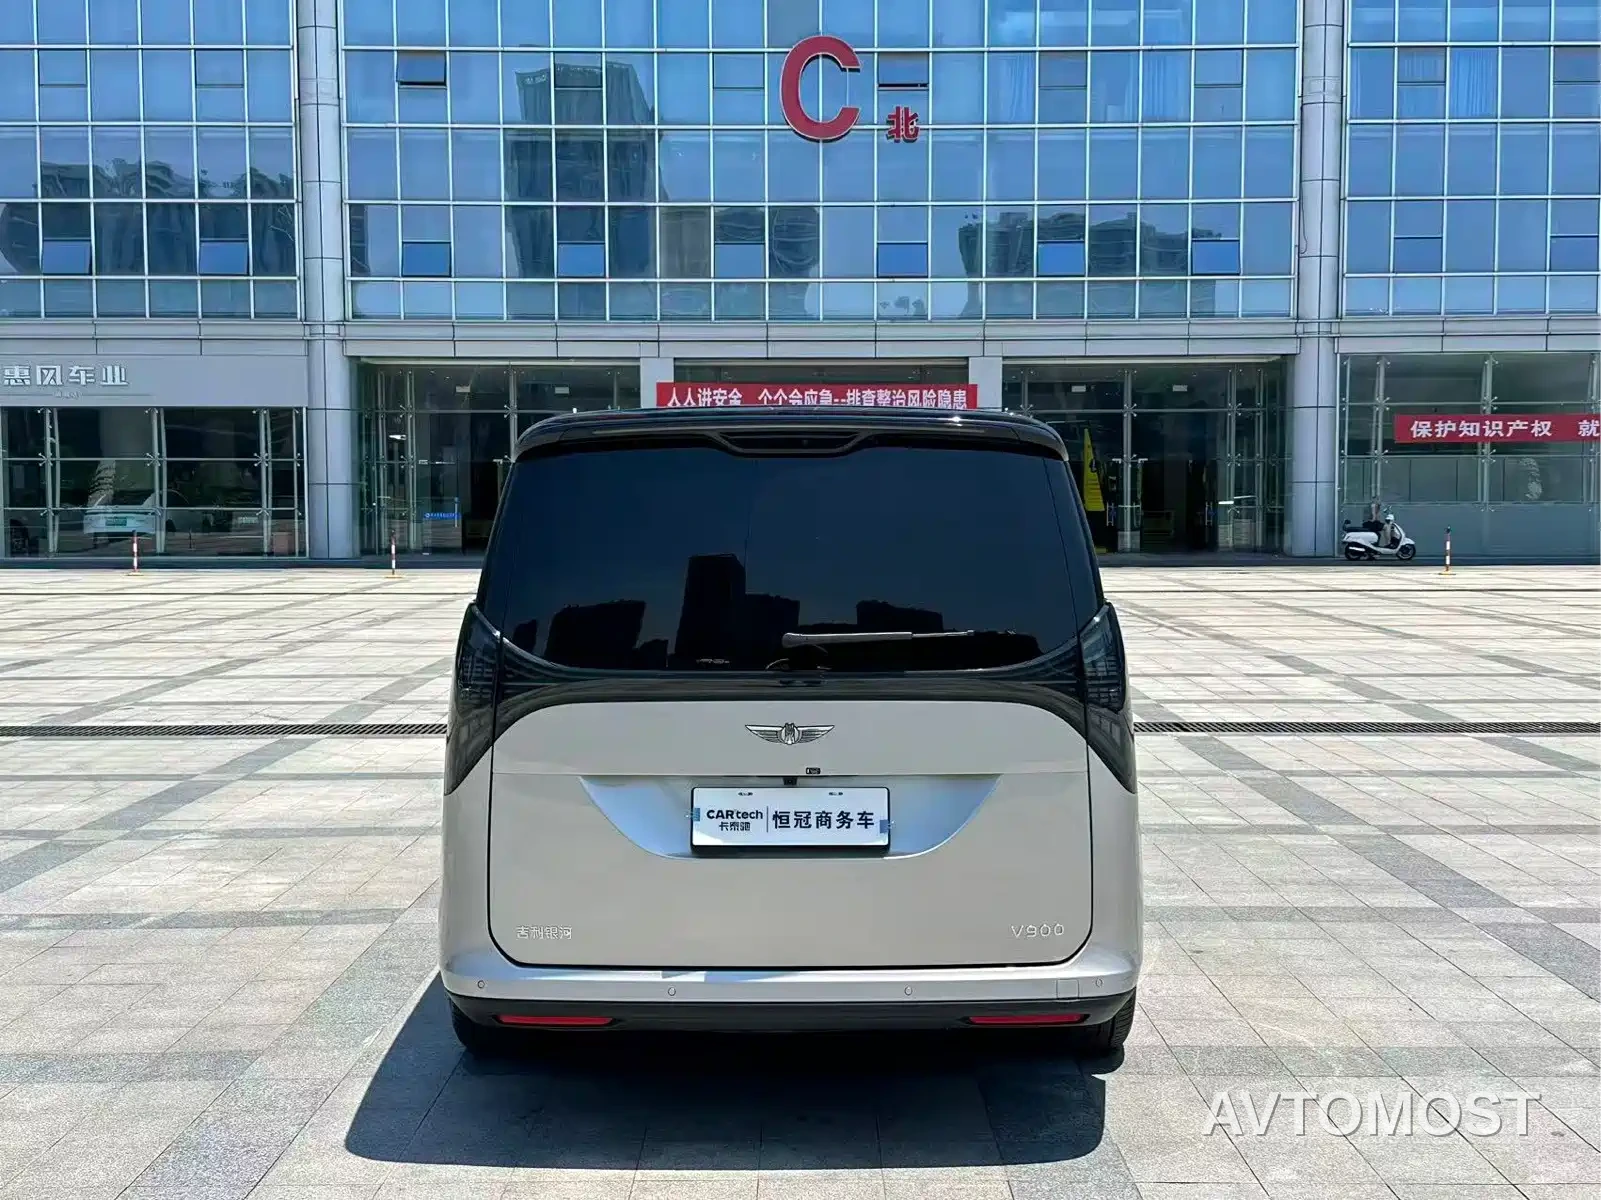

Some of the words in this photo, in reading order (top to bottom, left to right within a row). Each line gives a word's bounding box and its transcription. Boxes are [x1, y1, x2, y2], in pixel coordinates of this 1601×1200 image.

[780, 36, 862, 141] C
[887, 106, 920, 142] 北
[3, 365, 129, 386] 惠风车业
[667, 387, 743, 407] 人人讲安全
[1410, 420, 1552, 438] 保护知识产权
[1578, 420, 1601, 437] 就
[772, 811, 875, 830] 恒冠商务车
[516, 925, 572, 940] 吉利银河
[1010, 923, 1065, 938] V900
